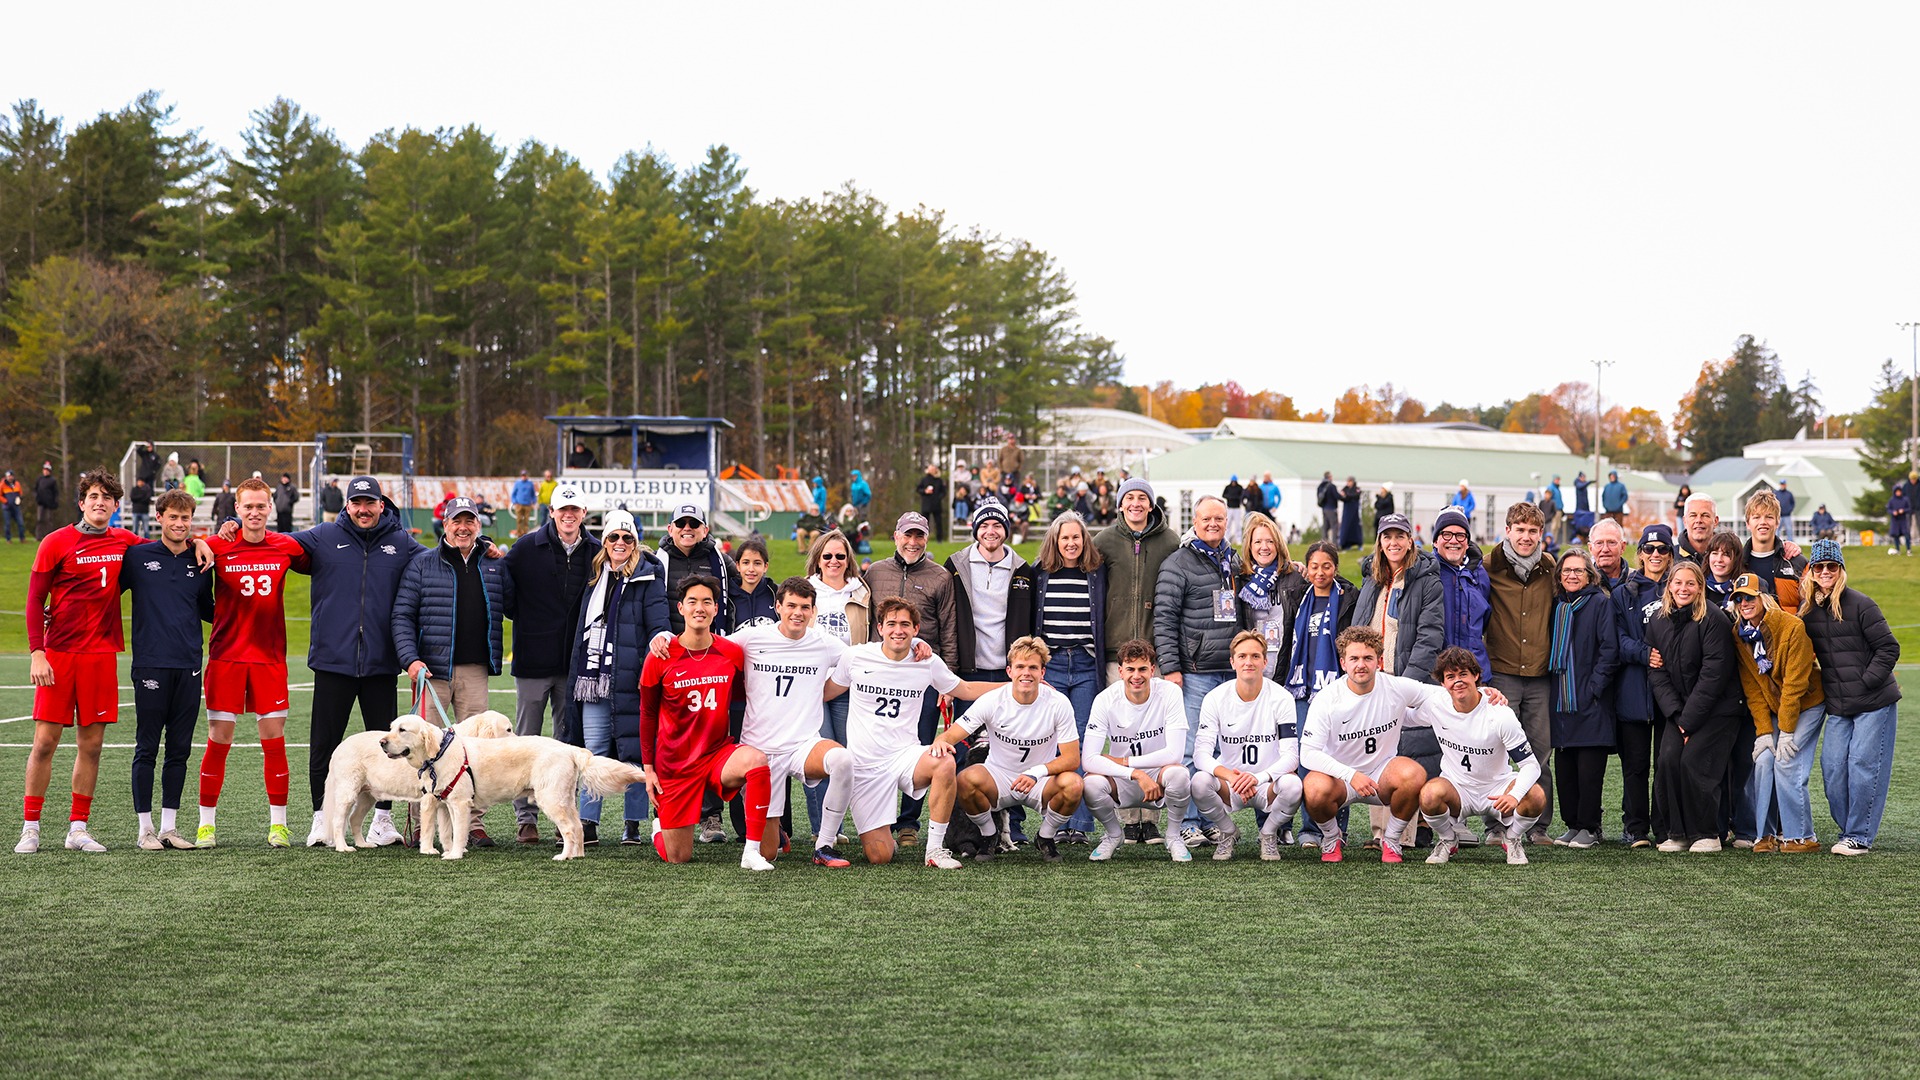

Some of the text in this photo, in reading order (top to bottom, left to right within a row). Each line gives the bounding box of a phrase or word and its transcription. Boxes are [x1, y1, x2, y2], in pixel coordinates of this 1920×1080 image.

[456, 498, 470, 508] M
[604, 498, 664, 509] SOCCER
[1648, 532, 1658, 541] M
[225, 563, 281, 573] MIDDLEBURY
[100, 567, 107, 588] 1
[240, 575, 272, 596] 33
[753, 663, 818, 675] MIDDLEBURY
[674, 675, 729, 689] MIDDLEBURY
[775, 675, 794, 697] 17
[856, 683, 922, 698] MIDDLEBURY
[687, 688, 718, 712] 34
[875, 697, 901, 719] 23
[1338, 718, 1398, 741] MIDDLEBURY
[994, 731, 1055, 746] MIDDLEBURY
[1365, 737, 1377, 754] 8
[1438, 736, 1495, 755] MIDDLEBURY
[1019, 747, 1030, 763] 7
[1130, 741, 1142, 756] 11
[1242, 744, 1258, 765] 10
[1461, 754, 1472, 772] 4
